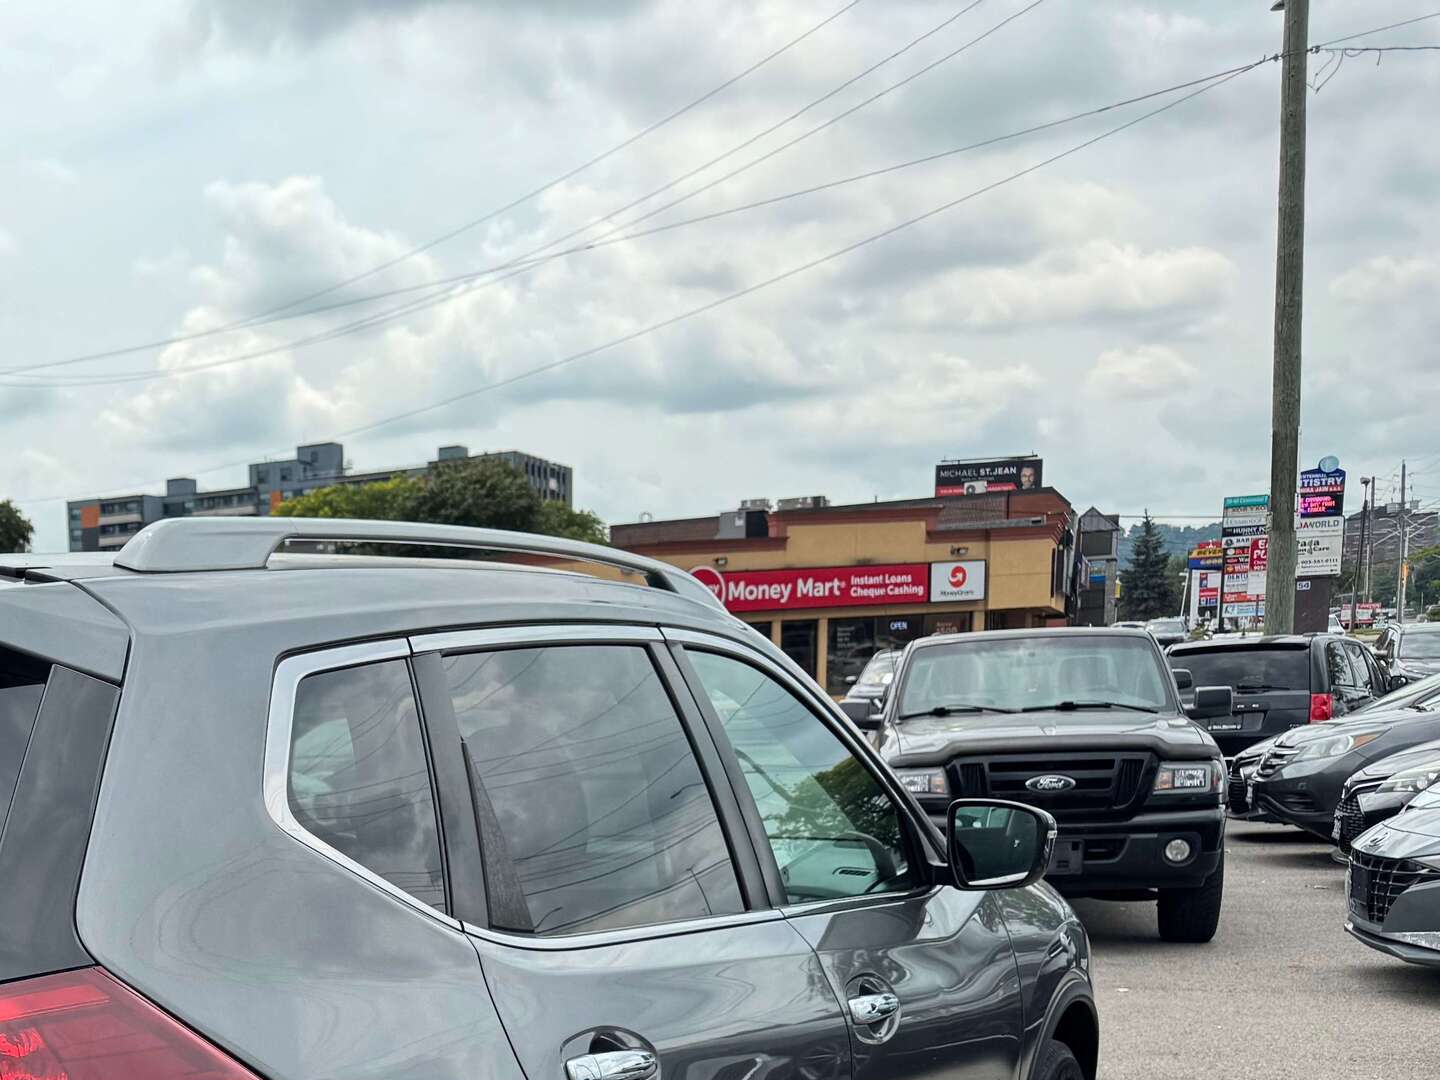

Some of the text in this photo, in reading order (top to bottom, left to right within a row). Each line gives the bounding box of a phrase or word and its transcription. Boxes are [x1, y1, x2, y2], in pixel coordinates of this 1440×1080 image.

[940, 469, 978, 478] MICHAEL
[851, 574, 912, 585] Instant Loans
[728, 580, 792, 603] Money
[797, 577, 842, 599] Mart
[850, 585, 924, 598] Cheque Cashing
[889, 621, 908, 631] OPEN
[1037, 778, 1065, 789] Ford
